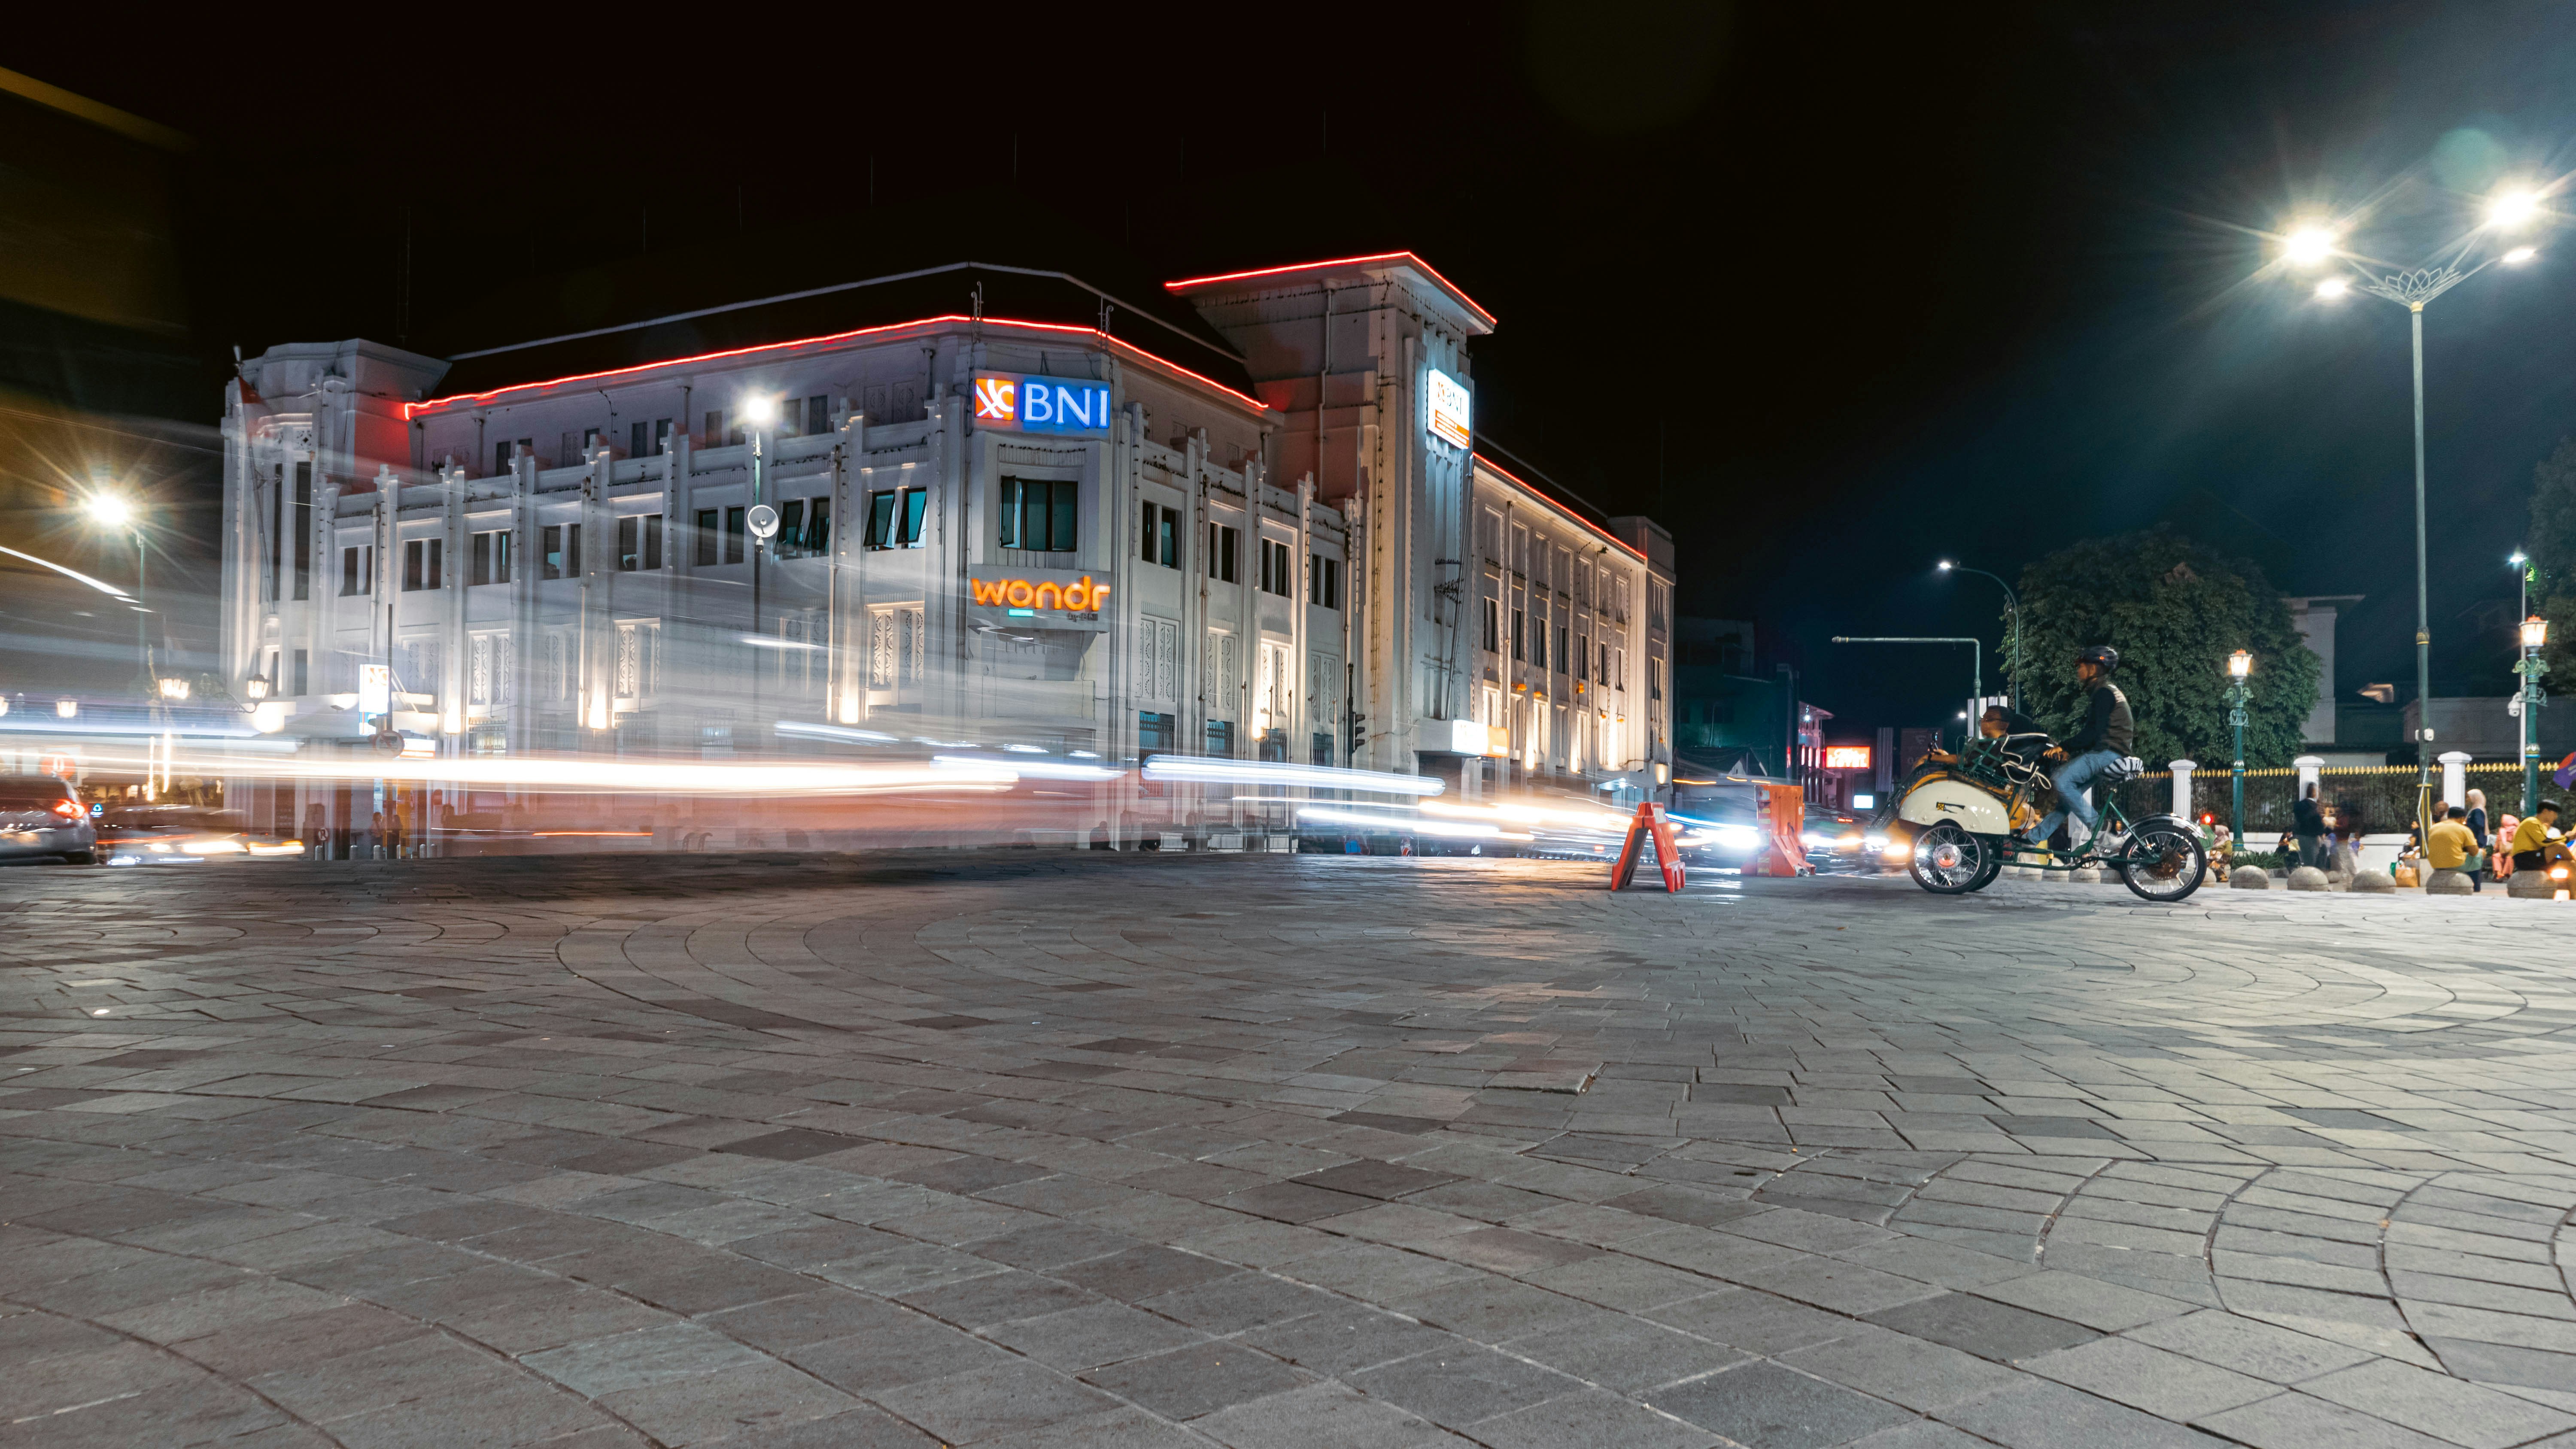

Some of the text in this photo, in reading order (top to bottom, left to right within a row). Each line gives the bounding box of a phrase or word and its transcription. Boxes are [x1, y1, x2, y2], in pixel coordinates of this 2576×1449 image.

[1023, 382, 1109, 428] BNI
[971, 576, 1111, 612] wondr
[1067, 612, 1077, 622] by
